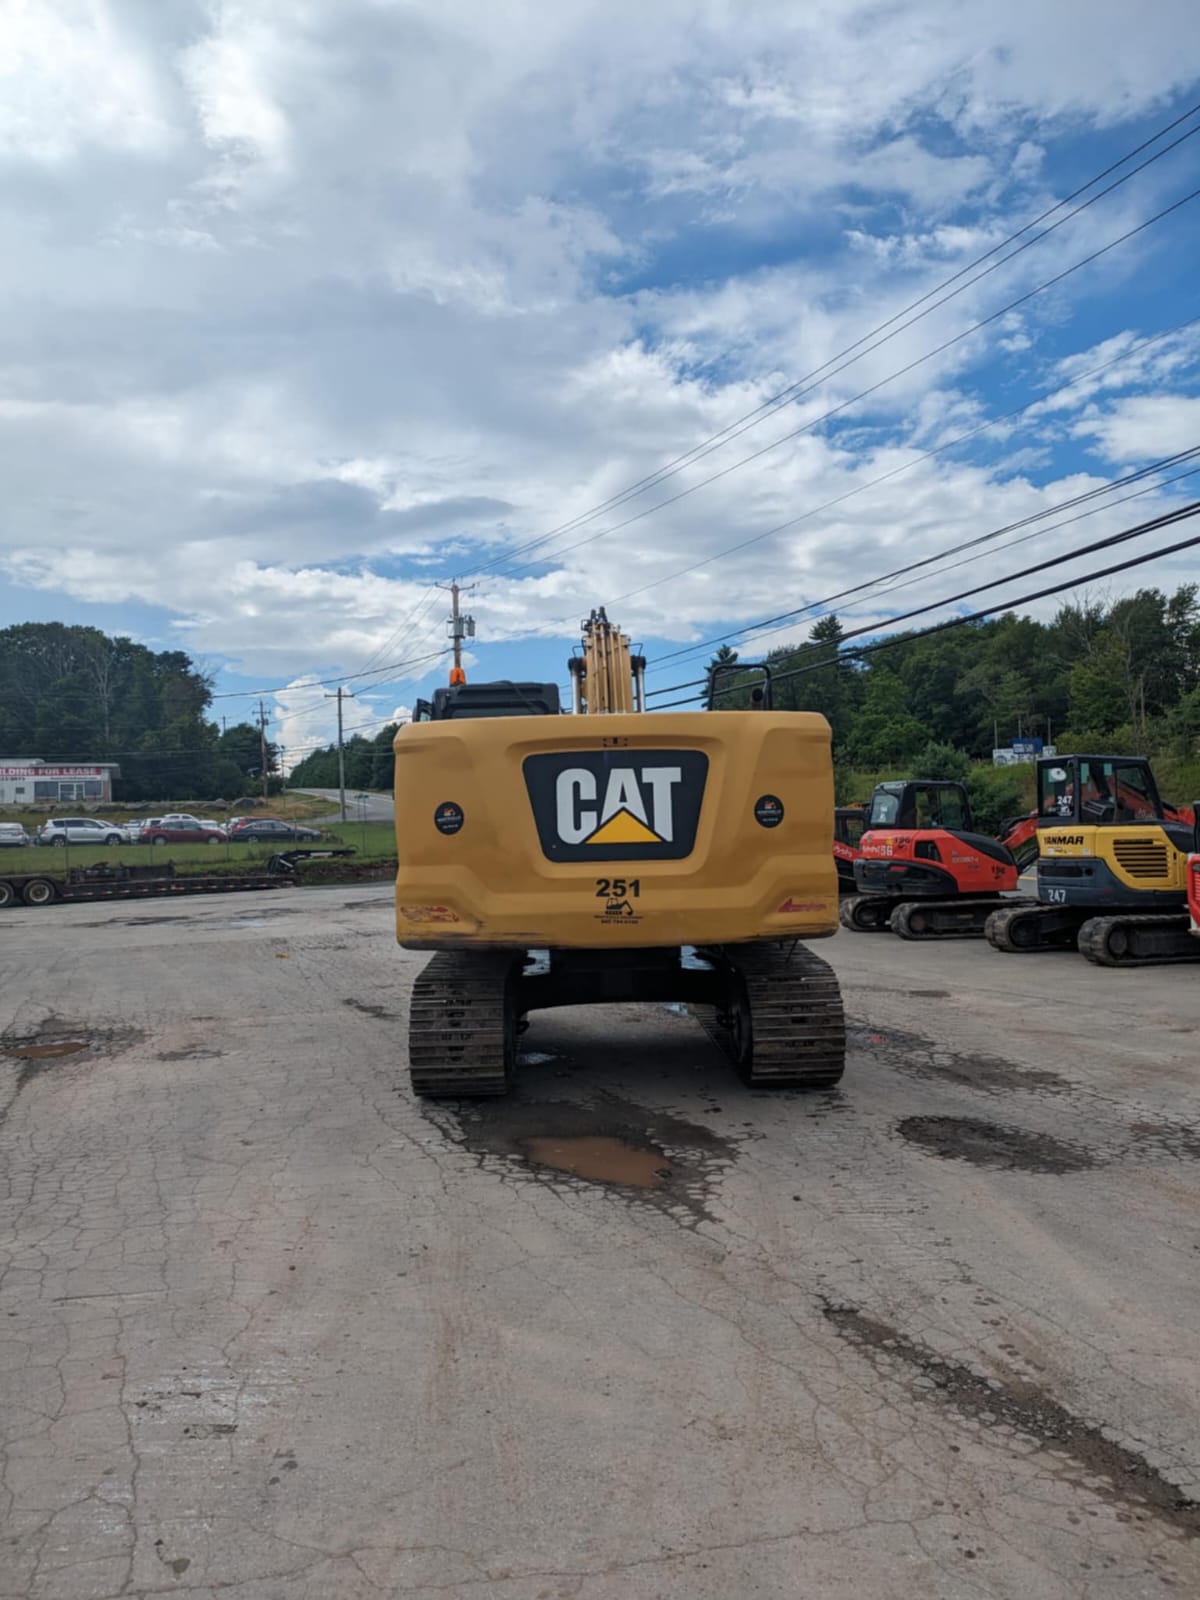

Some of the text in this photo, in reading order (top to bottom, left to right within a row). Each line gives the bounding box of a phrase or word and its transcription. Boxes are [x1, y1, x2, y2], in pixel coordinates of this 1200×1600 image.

[556, 767, 682, 844] CAT
[1057, 796, 1072, 804] 247
[596, 879, 640, 897] 251
[1048, 889, 1066, 902] 247
